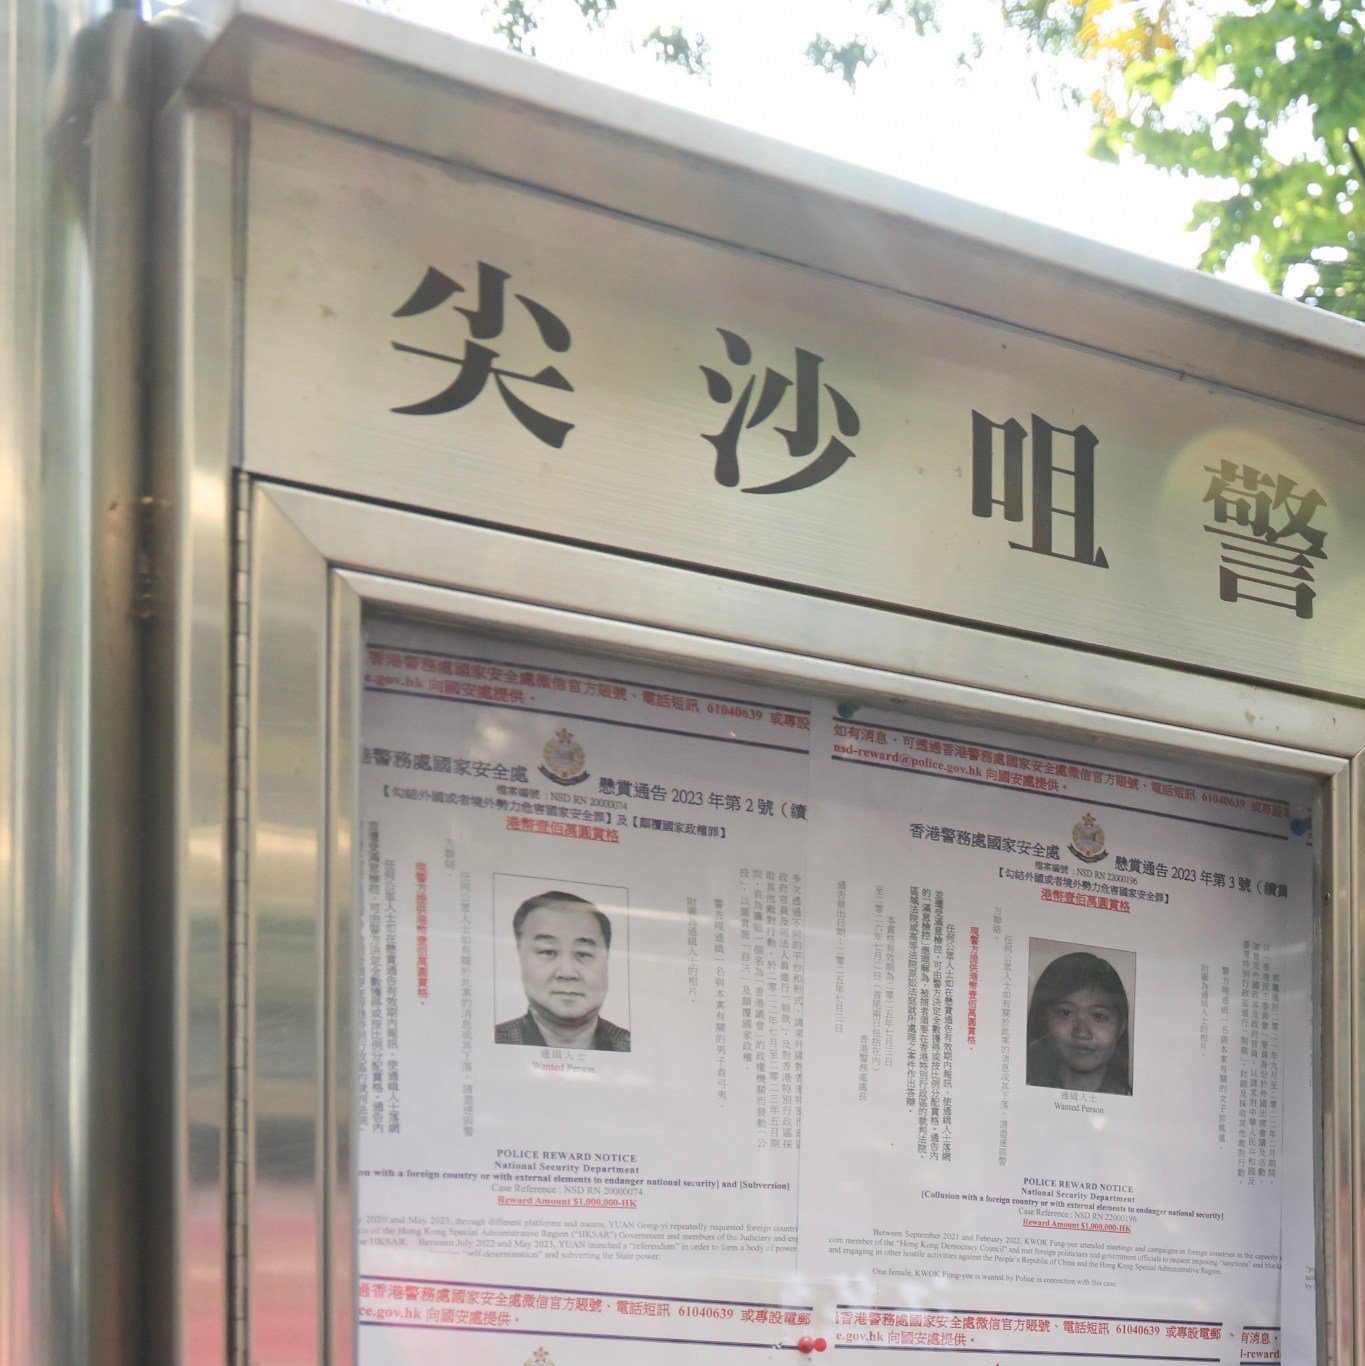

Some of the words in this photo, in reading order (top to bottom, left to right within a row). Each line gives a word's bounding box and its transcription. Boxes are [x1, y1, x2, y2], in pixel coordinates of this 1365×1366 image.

[707, 702, 762, 721] 61040639
[833, 742, 983, 778] nsd-reward@police.gov.hk
[599, 776, 667, 803] 懸賞通告
[672, 787, 703, 807] 2023
[709, 791, 741, 812] 年第
[746, 798, 754, 814] 2
[910, 823, 1060, 860] 香港警務處國家安全處
[1115, 855, 1168, 877] 懸賞通告
[1172, 865, 1197, 881] 2023
[1201, 867, 1225, 886] 年第
[1229, 875, 1235, 887] 3
[1108, 873, 1138, 884] 22000196
[1041, 888, 1130, 912] 港幣壹佰萬圓賞格
[497, 1150, 538, 1159] POLICE
[542, 1151, 591, 1161] REWARD
[595, 1153, 637, 1163] NOTICE
[495, 1161, 536, 1170] National
[539, 1163, 580, 1174] Security
[583, 1164, 639, 1176] Department
[678, 1307, 733, 1321] 61040639
[741, 1309, 810, 1326] 或專設電郵
[835, 1312, 1109, 1335] 香港警務處國家安全處微信官方賬號、電話短訊
[1116, 1325, 1159, 1336] 61040639
[1166, 1326, 1221, 1341] 或專設電郵
